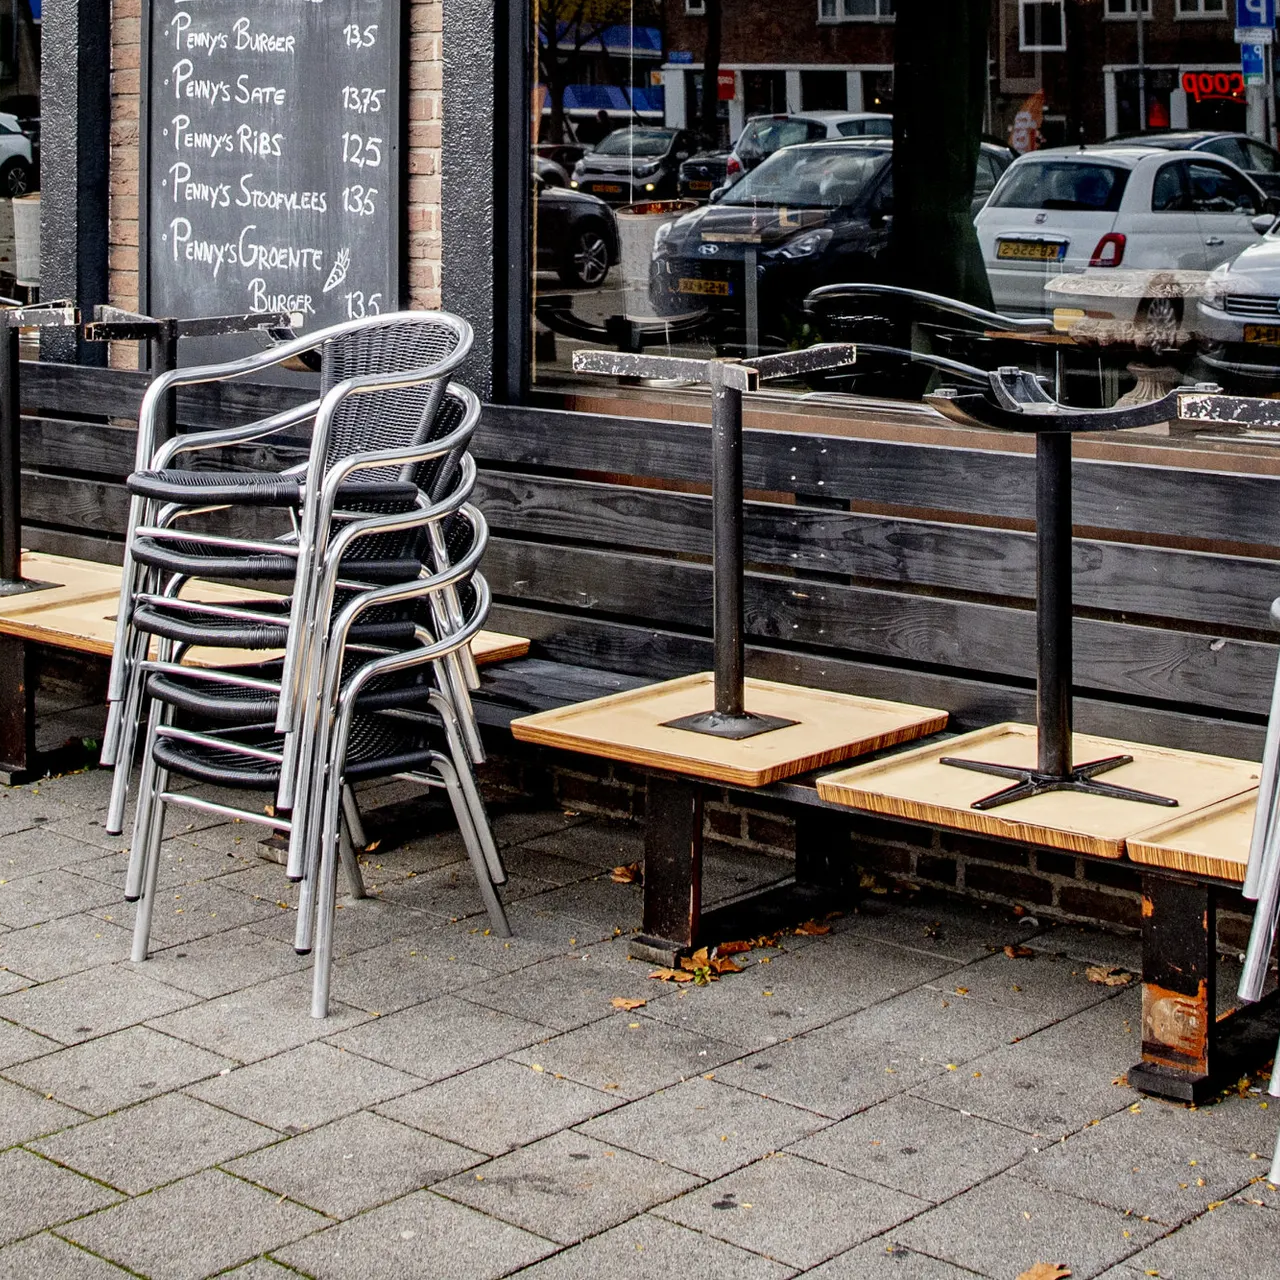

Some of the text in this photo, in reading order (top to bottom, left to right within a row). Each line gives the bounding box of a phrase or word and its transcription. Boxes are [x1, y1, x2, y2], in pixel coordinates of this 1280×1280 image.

[232, 16, 296, 54] BURGER
[342, 23, 379, 49] 13,5
[234, 74, 287, 106] SATE
[341, 85, 386, 114] 13,75
[341, 131, 383, 168] 12,5
[234, 173, 328, 213] STOOFVLEES
[341, 184, 379, 217] 13,5
[238, 224, 323, 271] GROENTE
[247, 277, 316, 314] BURGER
